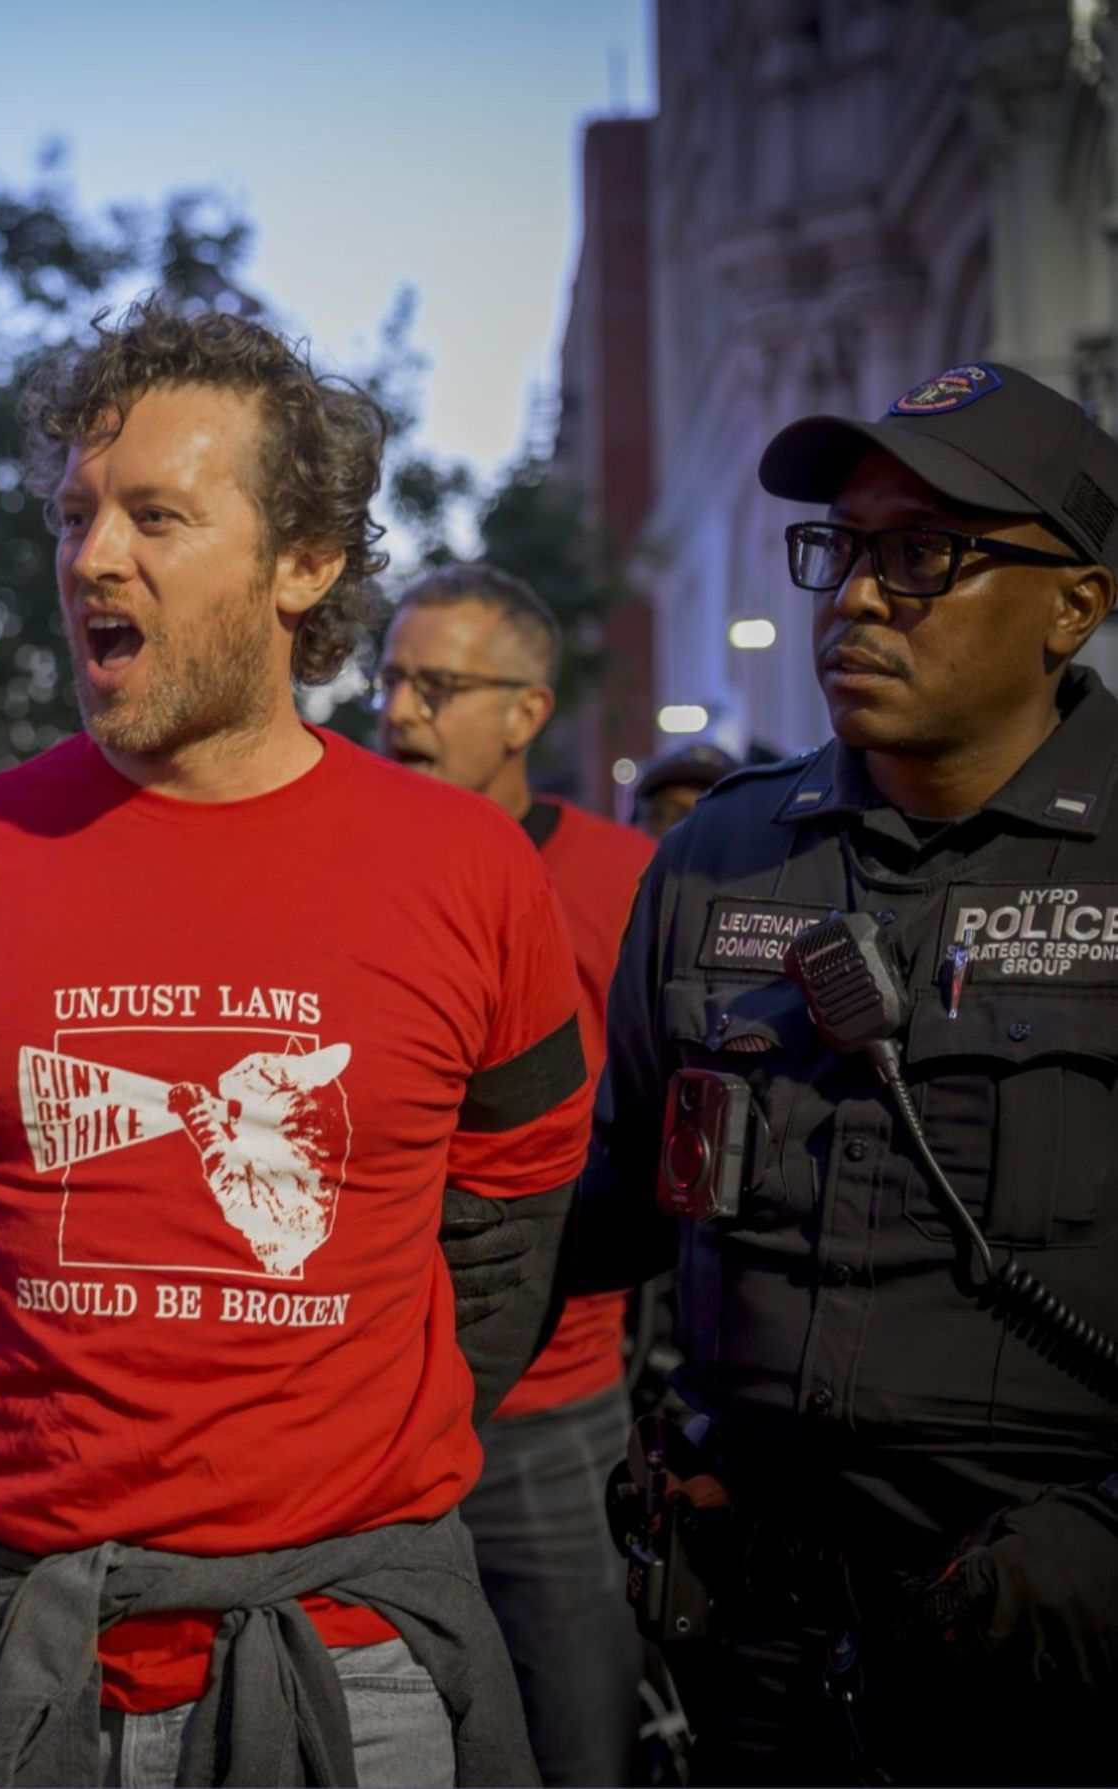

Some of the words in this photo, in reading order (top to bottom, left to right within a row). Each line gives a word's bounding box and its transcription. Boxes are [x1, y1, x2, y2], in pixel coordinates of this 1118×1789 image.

[1018, 888, 1079, 905] NYPD
[954, 904, 1118, 943] POLICE
[946, 941, 1039, 961] SRATEGIC
[1001, 958, 1072, 976] GROUP
[54, 984, 200, 1020] UNJUST
[218, 985, 321, 1024] LAWS
[32, 1053, 110, 1101] CUNY
[37, 1101, 71, 1122] ON
[40, 1104, 144, 1168] STRIKE
[15, 1277, 138, 1317] SHOULD
[155, 1285, 202, 1319] BE
[220, 1287, 350, 1327] BROKEN
